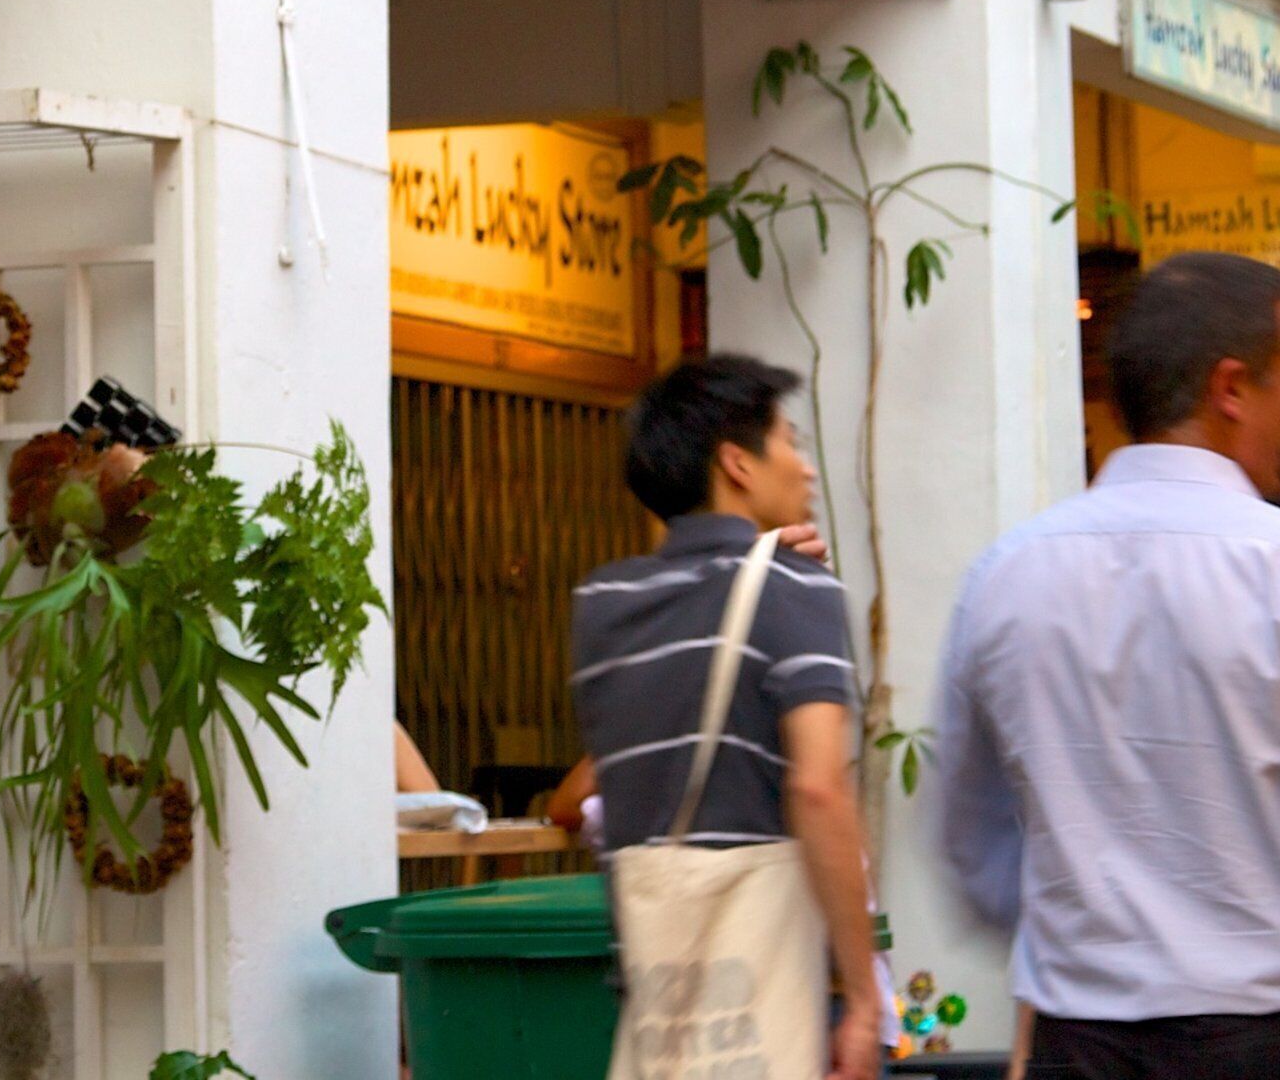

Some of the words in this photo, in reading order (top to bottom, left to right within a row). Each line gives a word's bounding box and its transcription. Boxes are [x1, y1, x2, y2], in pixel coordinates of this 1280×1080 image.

[1212, 24, 1256, 92] Lucky
[471, 150, 550, 289] Lucky
[558, 175, 622, 278] Store
[1143, 195, 1255, 237] Hamzah
